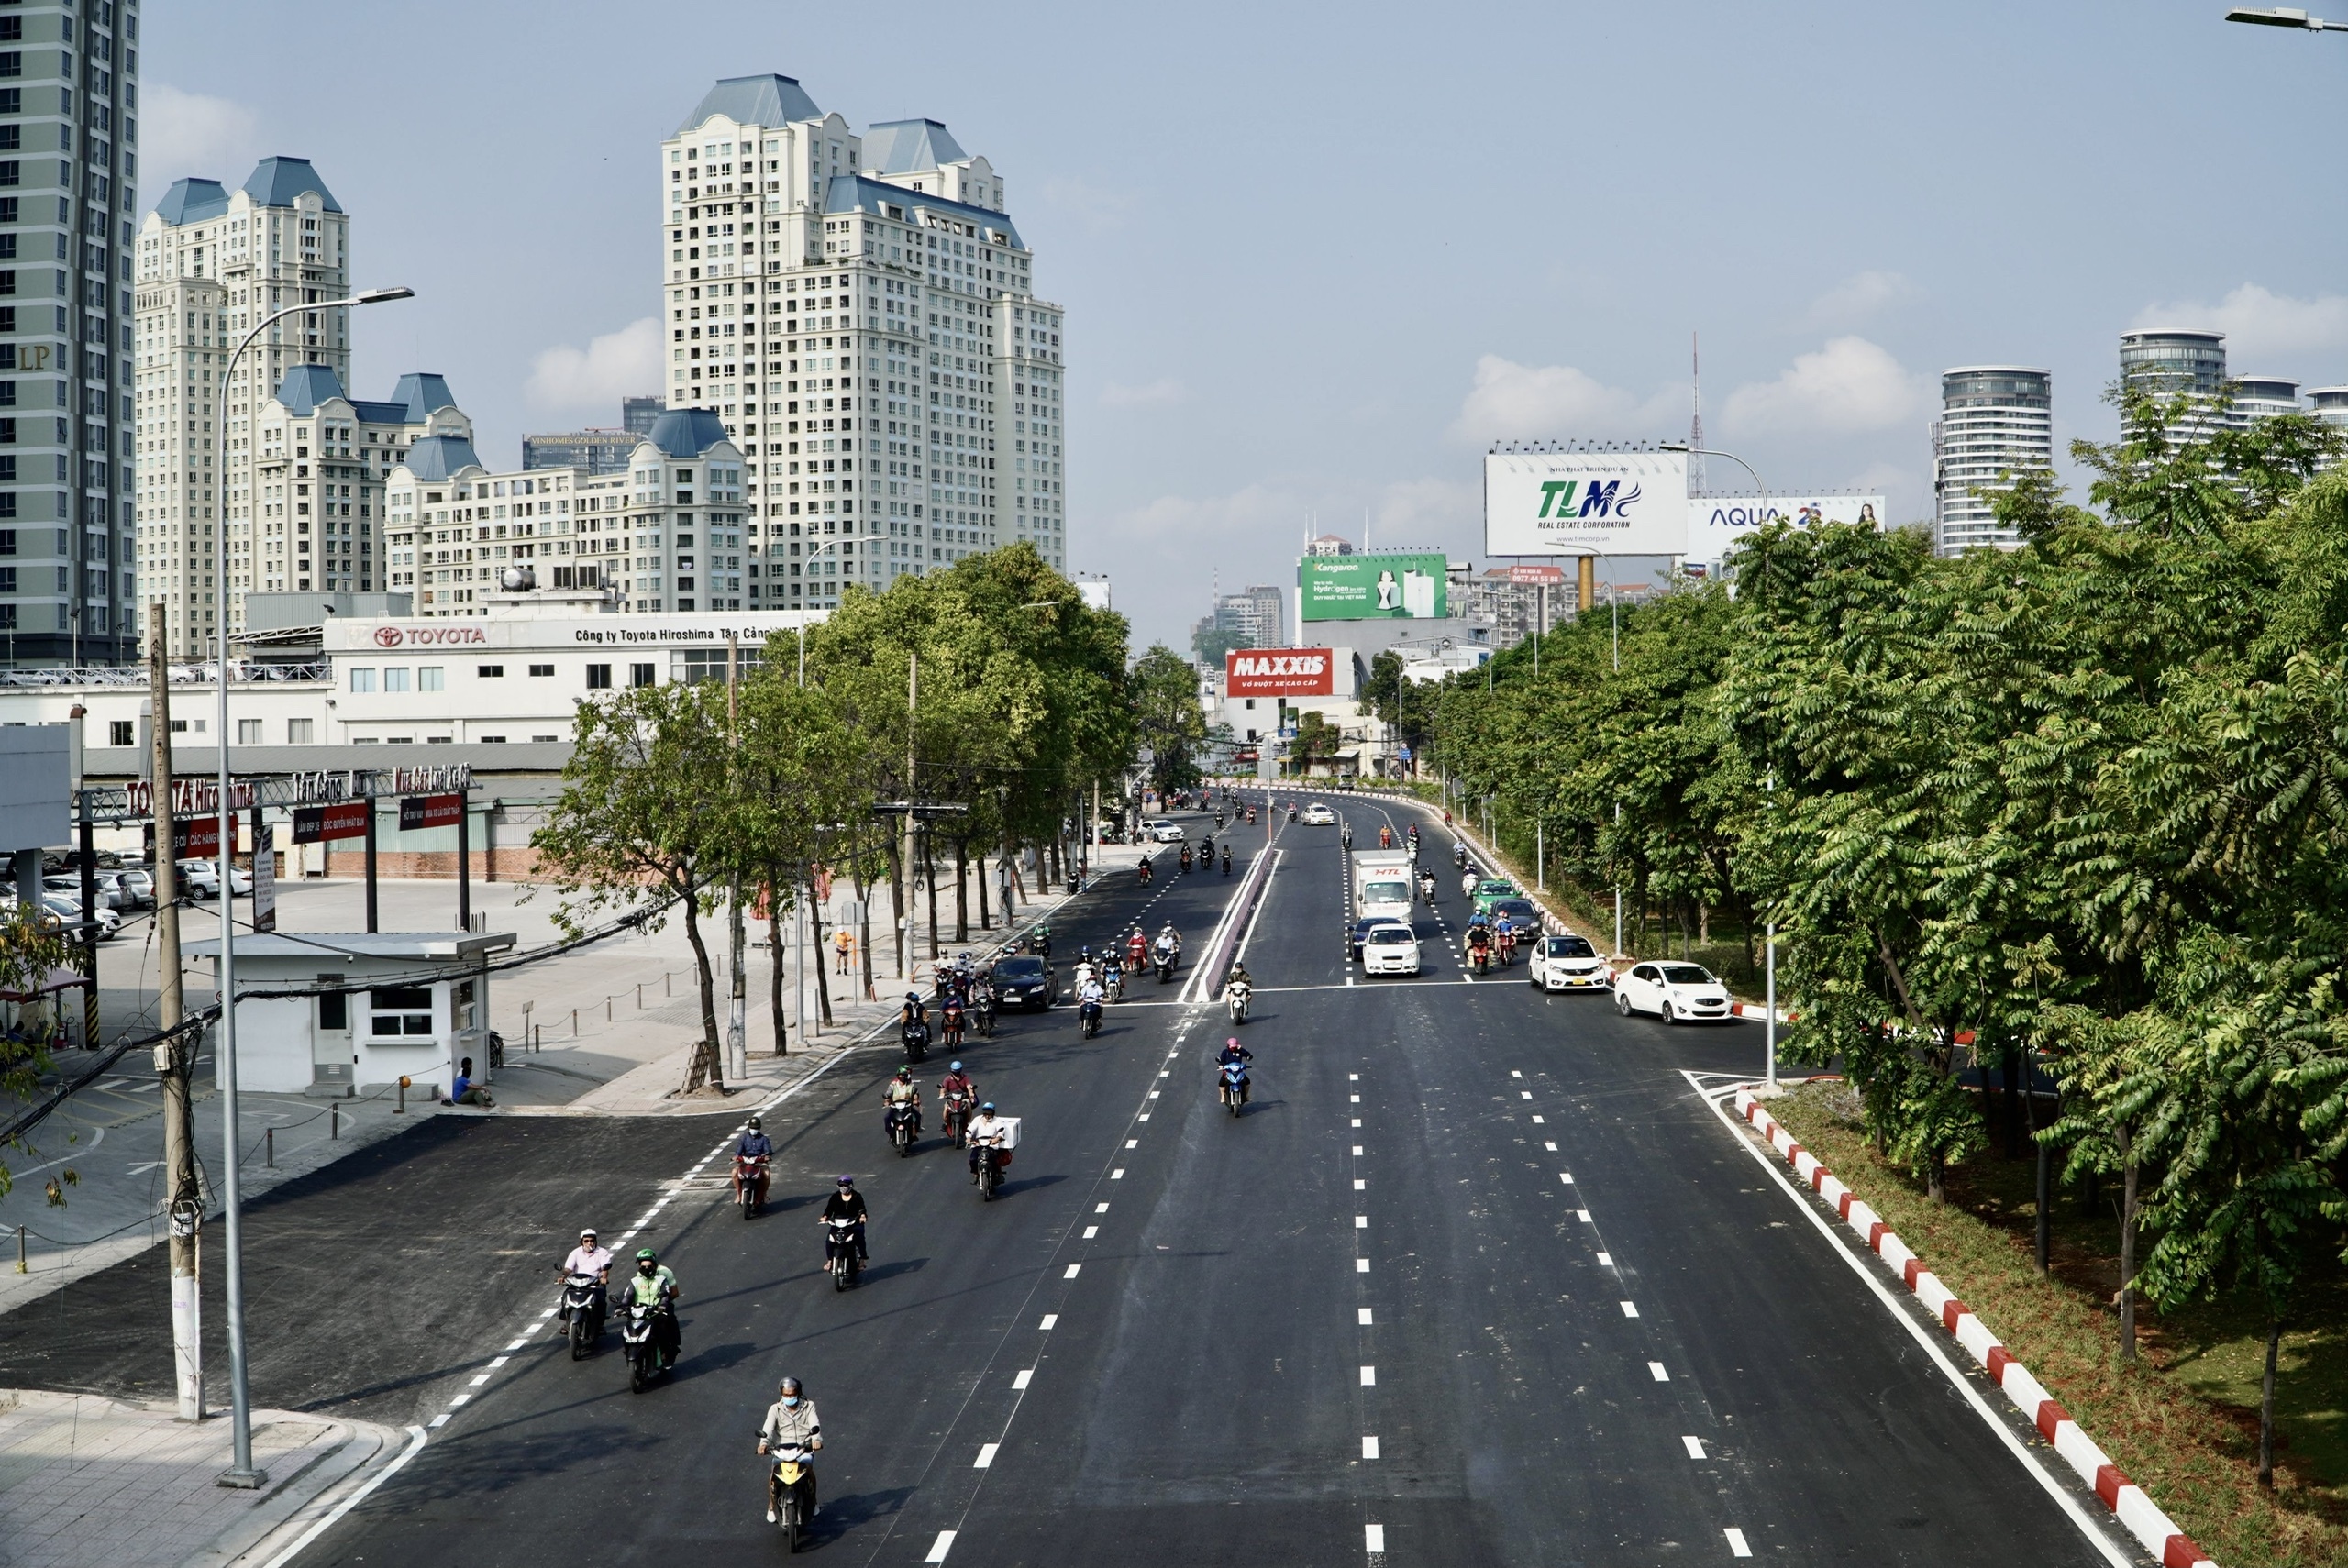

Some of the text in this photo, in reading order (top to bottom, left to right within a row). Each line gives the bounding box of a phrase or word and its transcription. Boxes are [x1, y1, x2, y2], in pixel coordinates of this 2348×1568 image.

[19, 346, 50, 370] LP
[532, 436, 573, 445] VINHOMES
[574, 436, 607, 445] GOLDEN
[1583, 521, 1631, 529] CORPORATION
[1314, 563, 1358, 573] Kangaroo
[1313, 585, 1349, 593] Hydrogen
[406, 627, 486, 644] TOYOTA
[576, 630, 603, 643] Công
[606, 630, 616, 643] ty
[620, 630, 657, 643] Toyota
[660, 629, 714, 640] Hiroshima
[720, 628, 738, 639] Tân
[1233, 656, 1324, 676] MAXXIS
[127, 780, 193, 816] TOTA
[190, 832, 202, 845] CÁC
[202, 831, 216, 845] HÃNG
